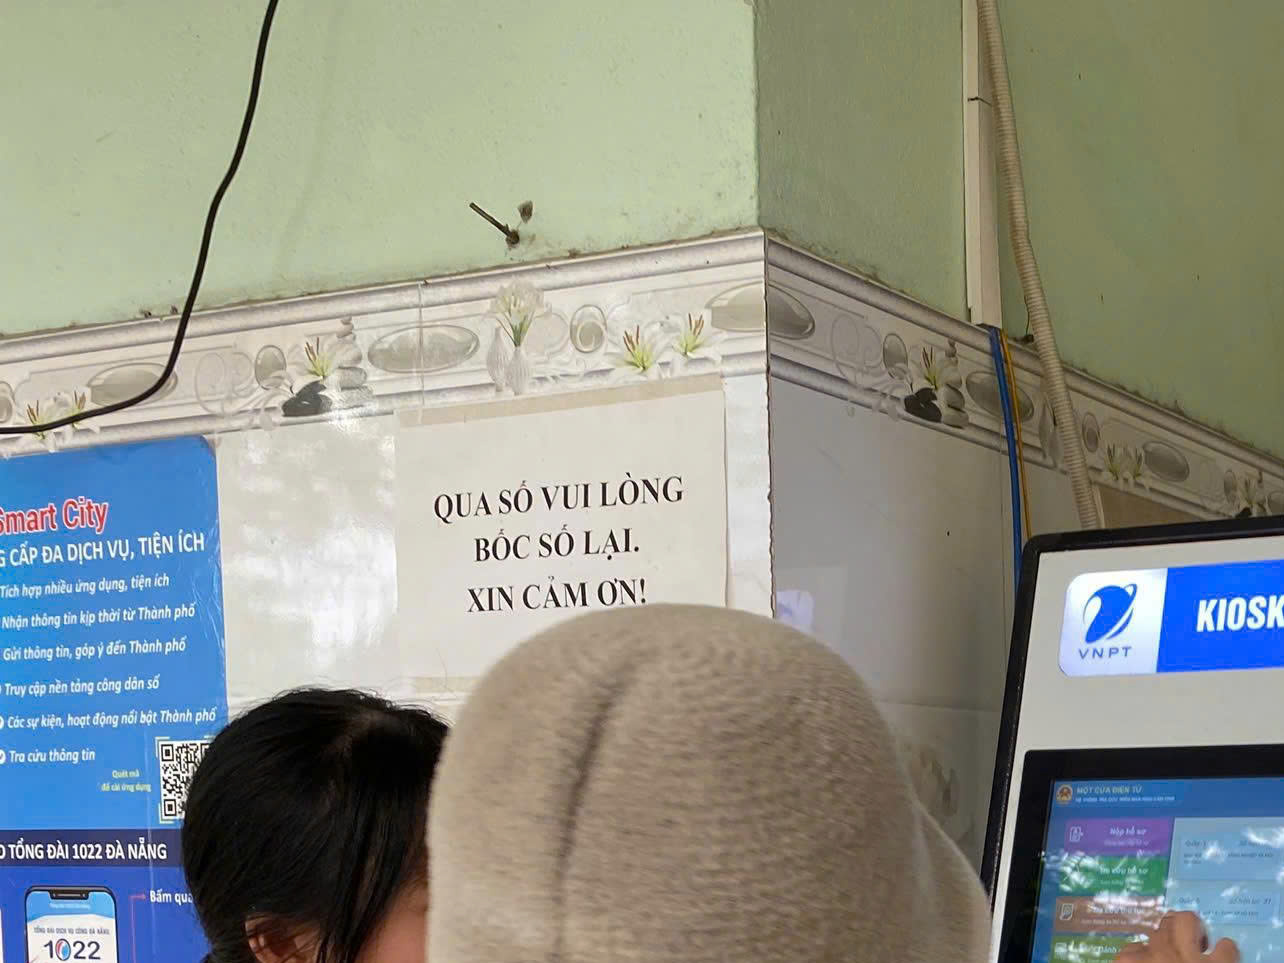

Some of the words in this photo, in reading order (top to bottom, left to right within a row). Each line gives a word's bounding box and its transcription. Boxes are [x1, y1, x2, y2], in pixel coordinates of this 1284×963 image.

[433, 491, 493, 524] QUA
[498, 480, 533, 515] SỐ
[540, 483, 592, 511] VUI
[600, 472, 684, 507] LÒNG
[62, 496, 109, 534] City
[10, 540, 38, 567] CẤP
[42, 544, 64, 564] ĐA
[67, 541, 103, 565] DỊCH
[107, 539, 135, 561] VỤ,
[138, 532, 173, 560] TIỆN
[178, 529, 205, 552] ÍCH
[474, 529, 531, 562] BỐC
[538, 524, 575, 558] SỐ
[583, 527, 641, 561] LẠI.
[0, 584, 19, 598] Tích
[22, 583, 42, 599] hợp
[44, 578, 72, 596] nhiều
[75, 579, 96, 595] ứng
[98, 576, 128, 593] dụng,
[131, 574, 151, 591] tiện
[154, 573, 170, 587] ích
[467, 585, 514, 613] XIN
[522, 575, 589, 610] CẢM
[597, 577, 647, 607] ƠN!
[1, 616, 29, 631] Nhận
[31, 613, 61, 628] thông
[63, 612, 78, 625] tin
[80, 610, 95, 626] kịp
[98, 607, 120, 623] thời
[123, 607, 136, 621] từ
[138, 605, 171, 620] Thành
[174, 601, 197, 621] phố
[3, 646, 21, 661] Gửi
[23, 645, 53, 661] thông
[75, 645, 95, 661] góp
[106, 639, 126, 655] đến
[129, 639, 162, 654] Thành
[165, 635, 187, 655] phố
[1078, 646, 1133, 660] VNPT
[5, 682, 26, 697] Truy
[28, 681, 47, 697] cập
[49, 678, 68, 693] nền
[71, 678, 94, 695] tảng
[96, 678, 121, 694] công
[124, 677, 144, 690] dân
[147, 673, 161, 690] số
[7, 716, 24, 729] Các
[27, 717, 40, 730] sự
[41, 715, 65, 729] kiện,
[67, 714, 91, 729] hoạt
[93, 712, 119, 728] động
[121, 709, 137, 724] nổi
[140, 710, 157, 726] bật
[160, 709, 192, 723] Thành
[195, 705, 217, 725] phố
[10, 751, 25, 763] Tra
[27, 750, 46, 763] cứu
[49, 748, 78, 764] thông
[81, 748, 95, 761] tin
[8, 837, 44, 859] TỔNG
[47, 839, 69, 859] ĐÀI
[72, 844, 102, 859] 1022
[105, 839, 125, 859] ĐÀ
[128, 836, 167, 859] NẴNG
[149, 888, 172, 903] Bấm
[44, 938, 101, 961] 1022
